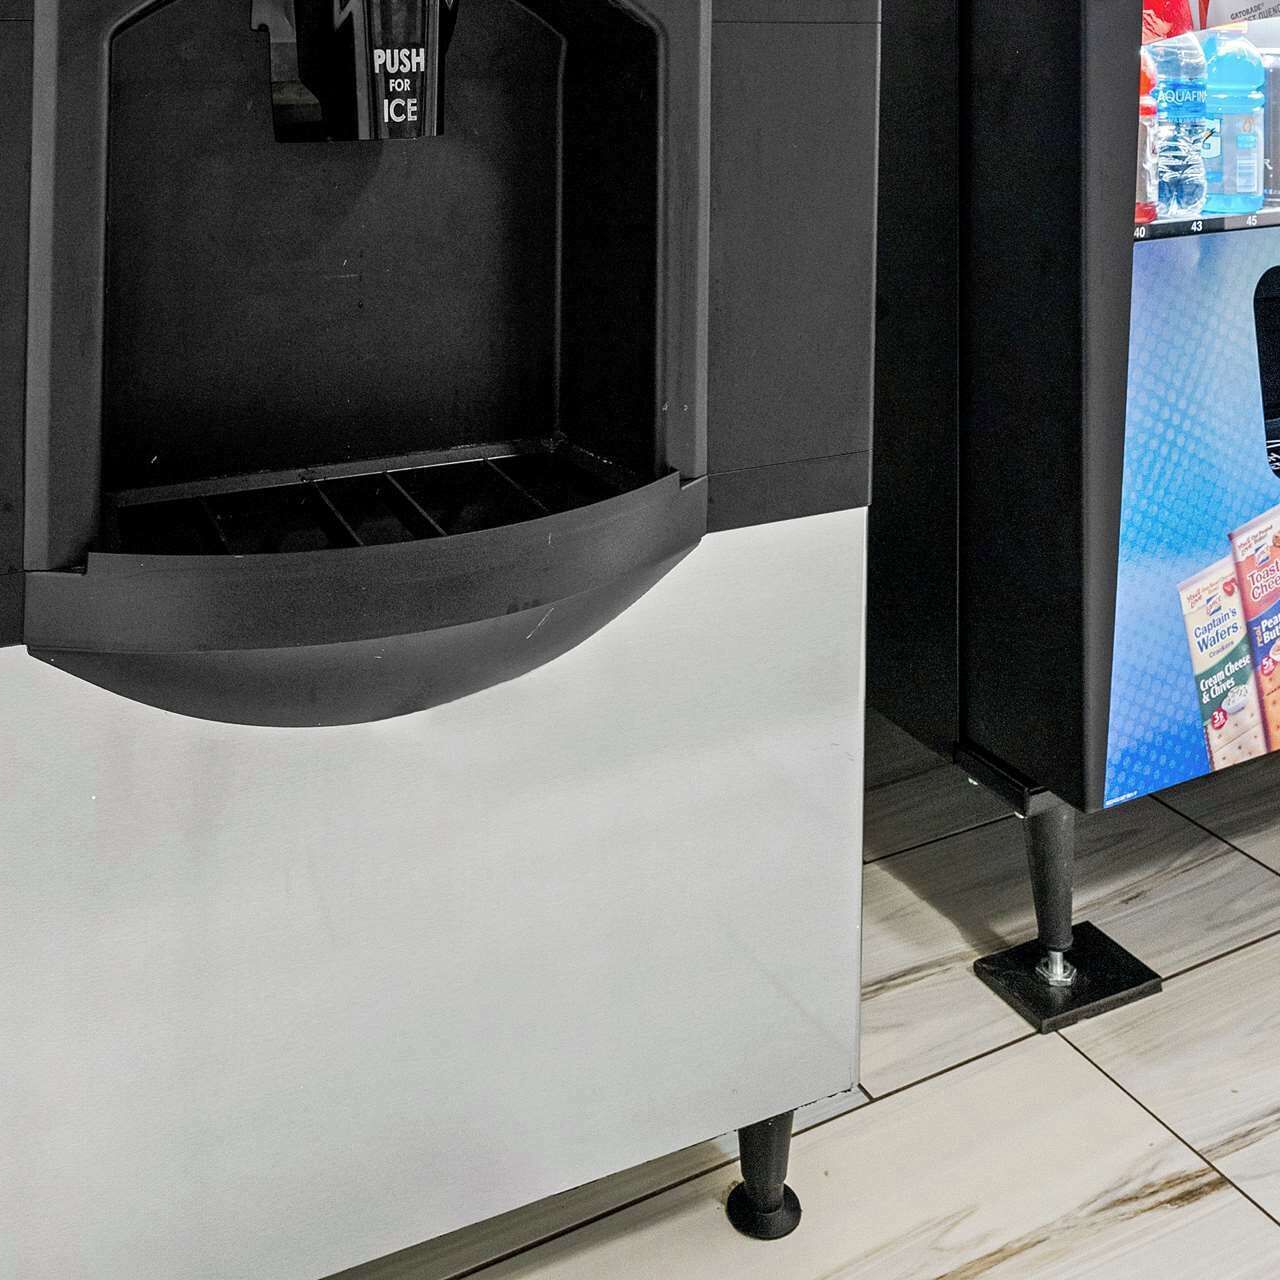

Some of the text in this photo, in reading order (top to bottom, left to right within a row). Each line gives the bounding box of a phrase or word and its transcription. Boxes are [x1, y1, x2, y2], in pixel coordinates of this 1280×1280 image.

[1230, 4, 1263, 20] GATORADE
[373, 47, 425, 74] PUSH
[389, 79, 411, 92] FOR
[383, 98, 418, 123] ICE
[1133, 226, 1146, 238] 40
[1191, 221, 1203, 232] 43
[1246, 216, 1257, 226] 45
[1248, 559, 1280, 587] Toast
[1193, 607, 1238, 639] Captain's
[1196, 621, 1240, 655] Wafers
[1199, 653, 1251, 692] Cream Cheese
[1202, 676, 1236, 704] & Chives
